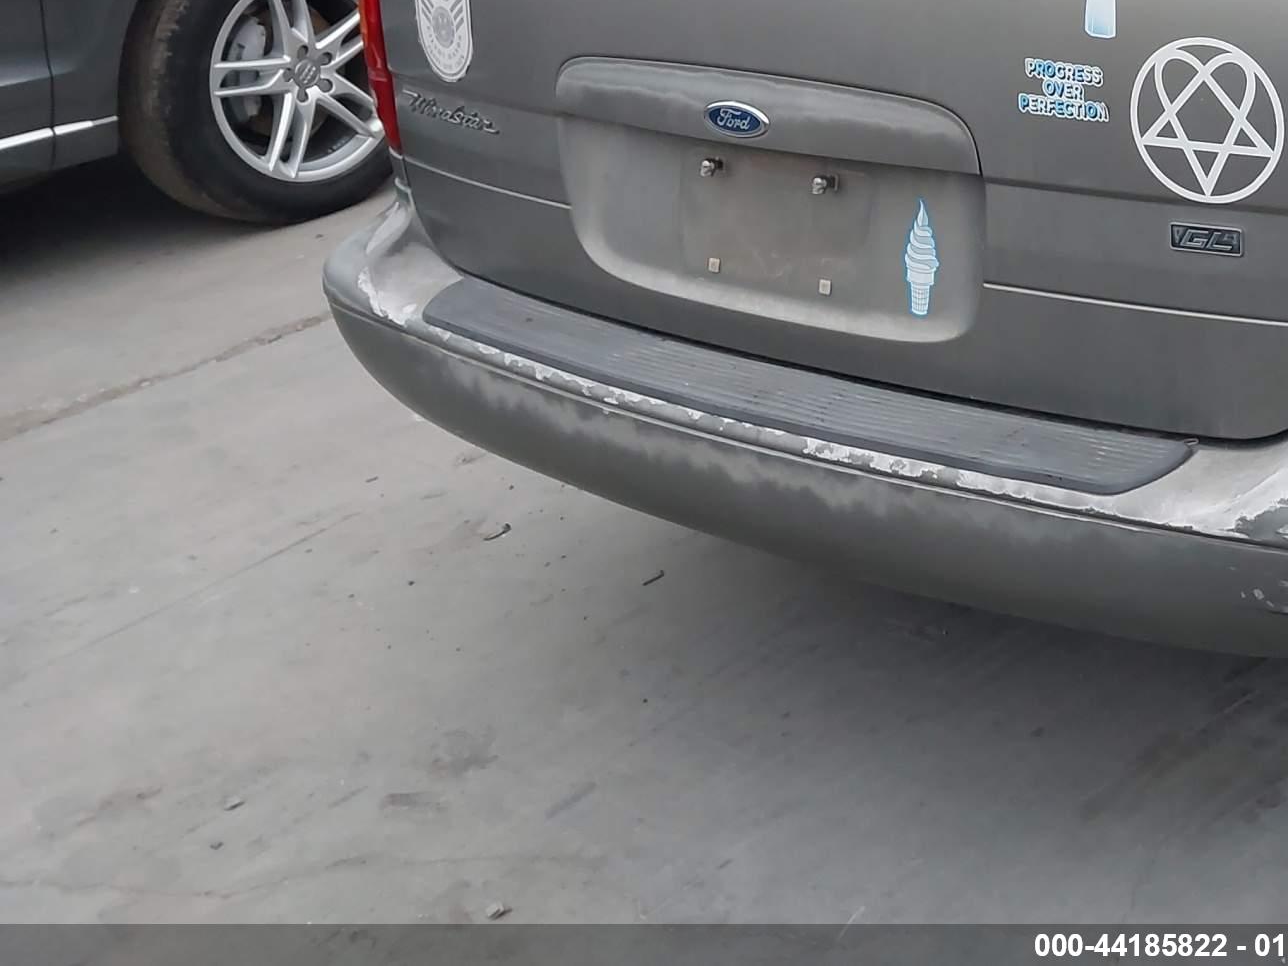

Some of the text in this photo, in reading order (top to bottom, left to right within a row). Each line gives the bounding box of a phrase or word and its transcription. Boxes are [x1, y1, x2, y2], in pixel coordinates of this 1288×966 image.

[1025, 58, 1103, 87] PROGRESS
[1043, 79, 1084, 100] OVER
[716, 108, 751, 130] Ford
[1018, 93, 1109, 122] PERFECTION
